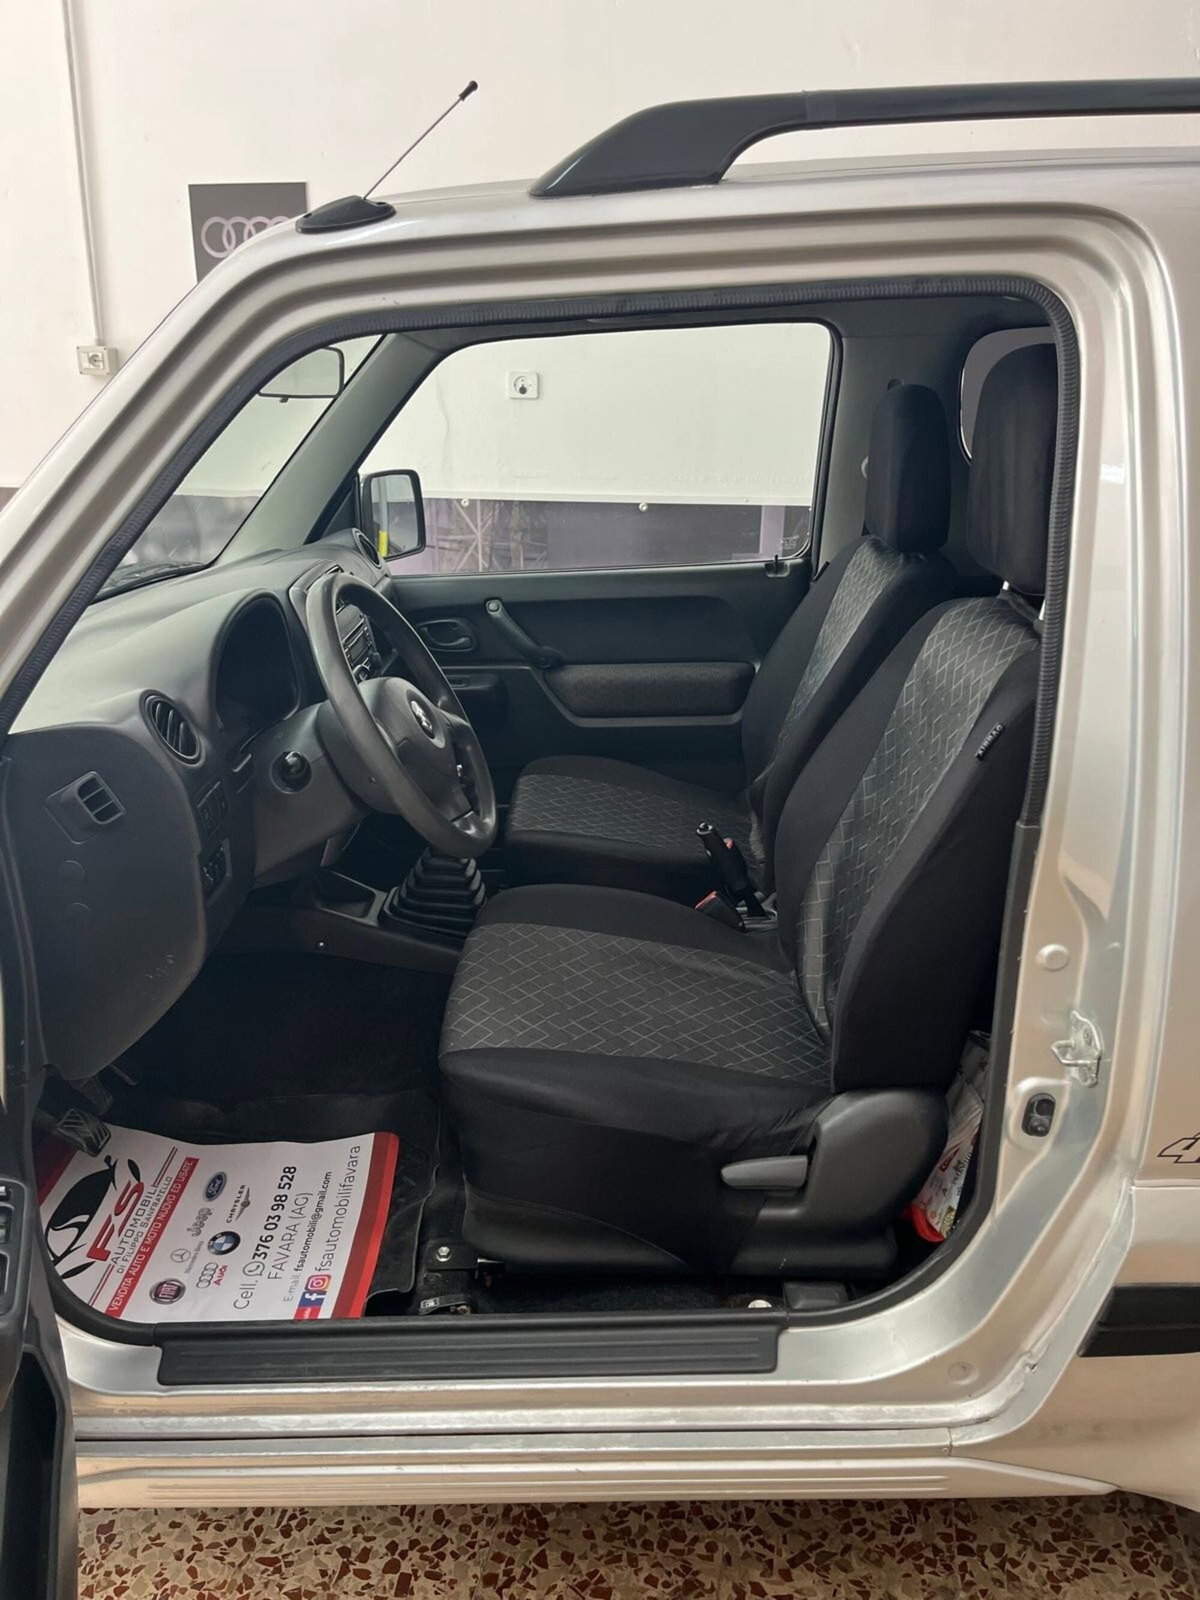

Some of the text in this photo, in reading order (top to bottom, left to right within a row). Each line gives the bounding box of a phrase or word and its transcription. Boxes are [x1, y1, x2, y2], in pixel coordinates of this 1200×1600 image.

[87, 1180, 144, 1261] FS
[108, 1277, 133, 1311] VENDITA
[129, 1254, 146, 1276] AUTO
[144, 1222, 162, 1245] MOTO
[158, 1194, 176, 1221] NUOVO
[170, 1183, 181, 1193] ED
[179, 1160, 193, 1182] USATE
[111, 1184, 158, 1265] AUTOMOBILI
[122, 1231, 144, 1262] FILIPPO
[140, 1176, 173, 1229] SANFRATELLO
[187, 1207, 213, 1237] Jeep
[226, 1184, 246, 1223] CHRYSLER
[233, 1166, 297, 1310] Cell. 376 03 98 528
[267, 1192, 313, 1280] FAVARA (AG)
[293, 1171, 333, 1273] fsautomobili@gmail.com
[315, 1145, 361, 1273] fsautomobilifavara
